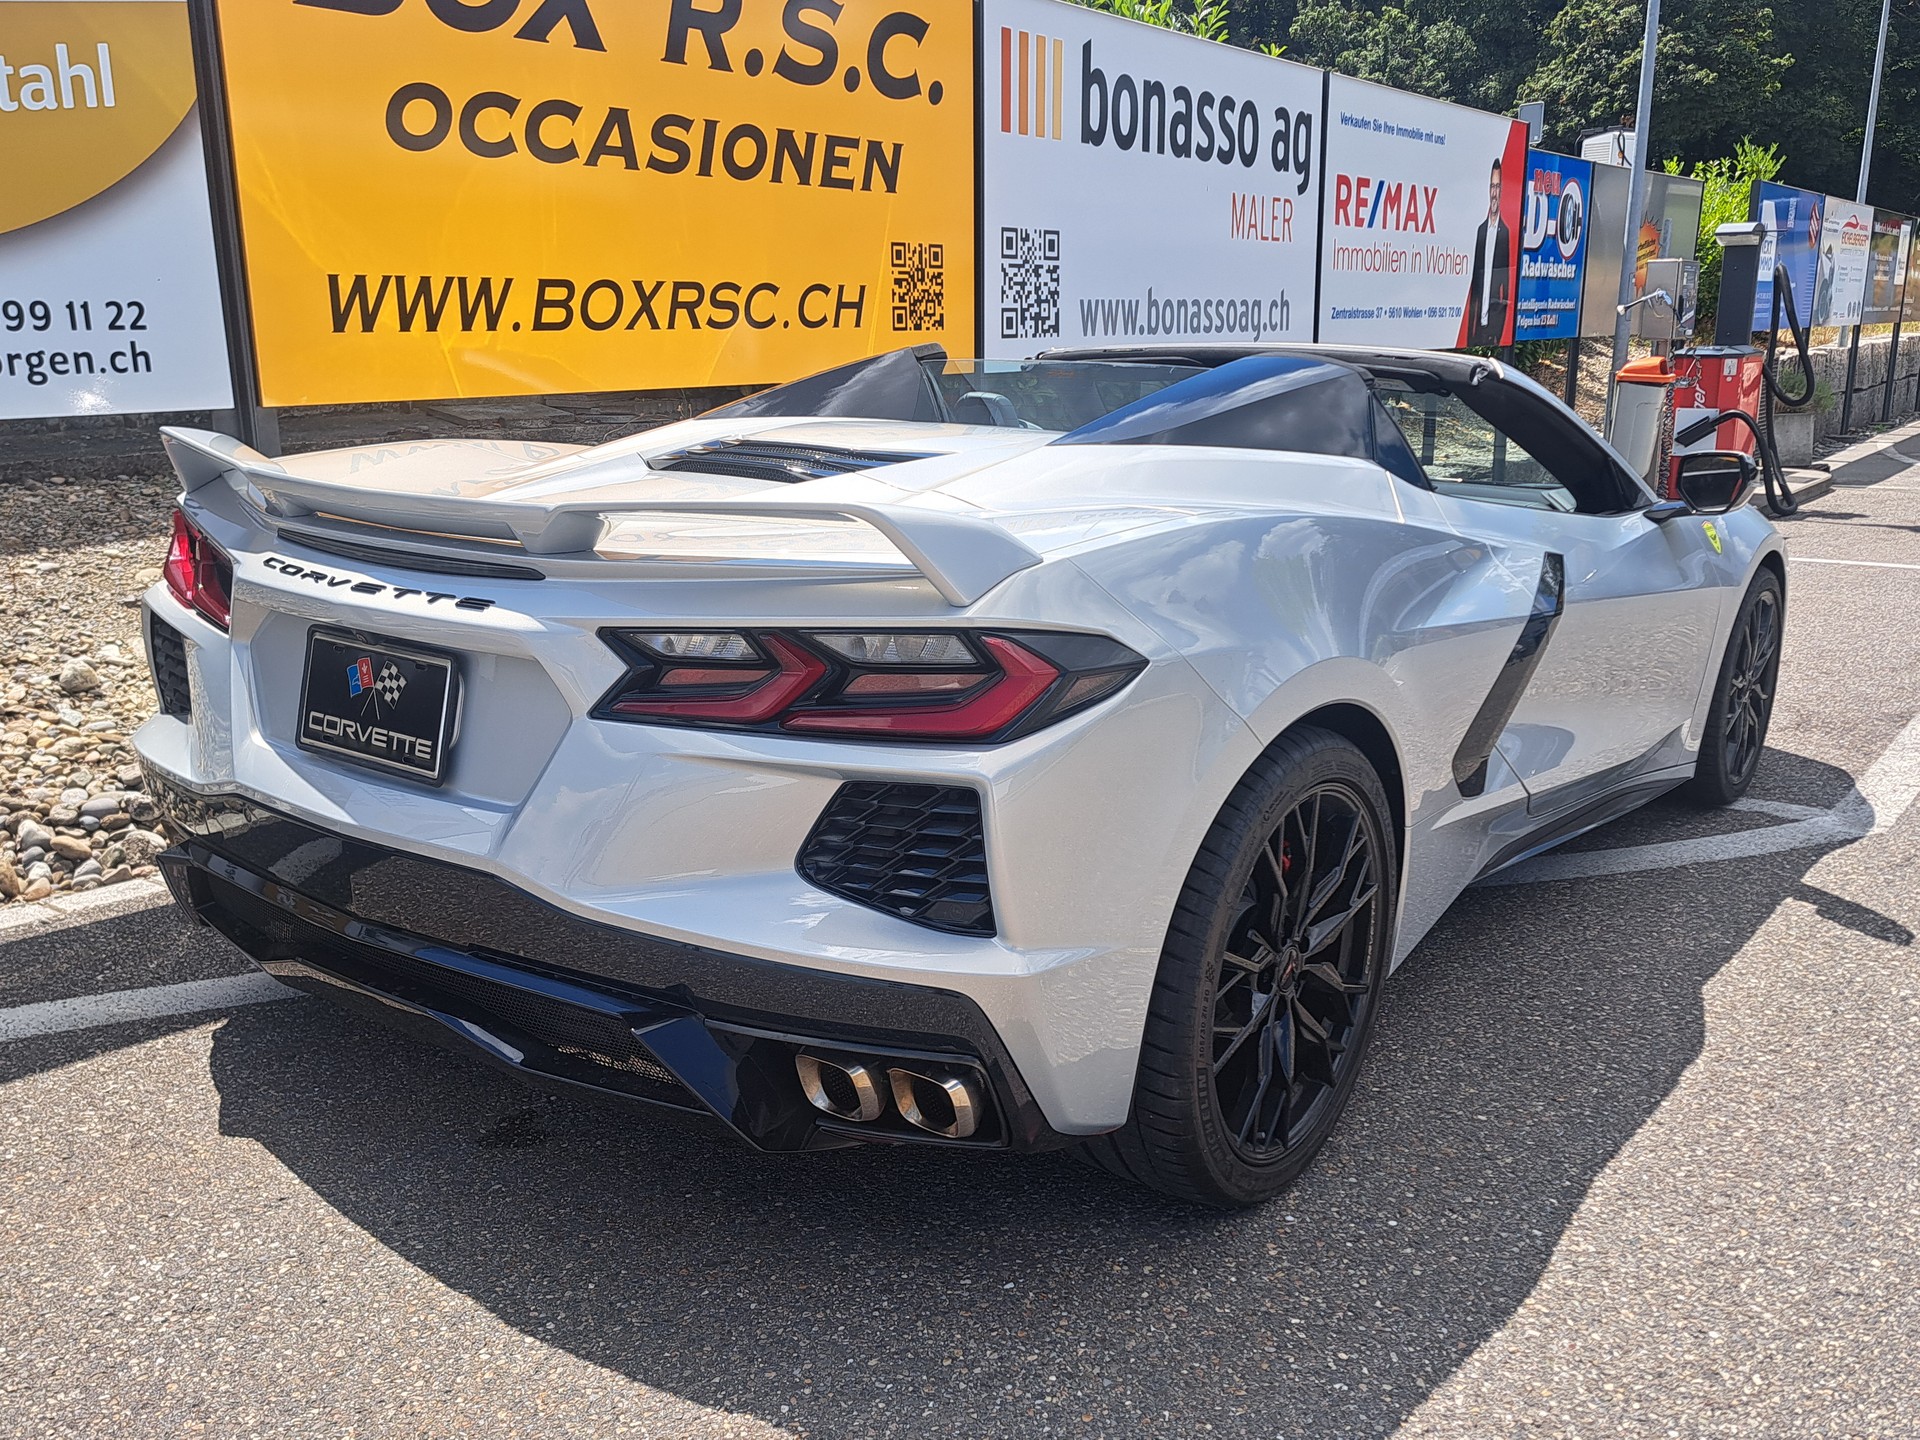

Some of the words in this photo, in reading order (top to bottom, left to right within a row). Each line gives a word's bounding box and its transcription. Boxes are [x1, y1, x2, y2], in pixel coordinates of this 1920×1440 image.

[660, 0, 944, 105] R.S.C.
[385, 82, 904, 194] OCCASIONEN
[1081, 38, 1259, 168] bonasso
[1271, 106, 1313, 196] ag
[1340, 111, 1371, 131] Verkaufen
[1372, 118, 1382, 133] Sie
[1383, 121, 1395, 135] Ihre
[1396, 123, 1424, 141] Immobilie
[1424, 130, 1434, 143] mit
[1434, 134, 1446, 145] uns!
[1231, 192, 1293, 243] MALER
[1334, 174, 1438, 234] RE/MAX
[1333, 238, 1407, 273] Immobilien
[1411, 244, 1422, 274] in
[1426, 245, 1469, 275] Wohlen
[1521, 254, 1576, 278] Radwäscher
[2, 300, 52, 332] 99
[65, 301, 92, 331] 11
[105, 301, 147, 331] 22
[327, 274, 867, 333] WWW.BOXRSC.CH
[1079, 286, 1290, 343] www.bonassoag.ch
[1331, 307, 1375, 319] Zentralstrasse
[1376, 307, 1383, 318] 37
[1388, 306, 1402, 318] 5610
[1402, 307, 1423, 318] Wohlen
[0, 341, 152, 386] rgen.ch
[263, 556, 496, 612] CORVETTE
[308, 710, 433, 760] CORVETTE
